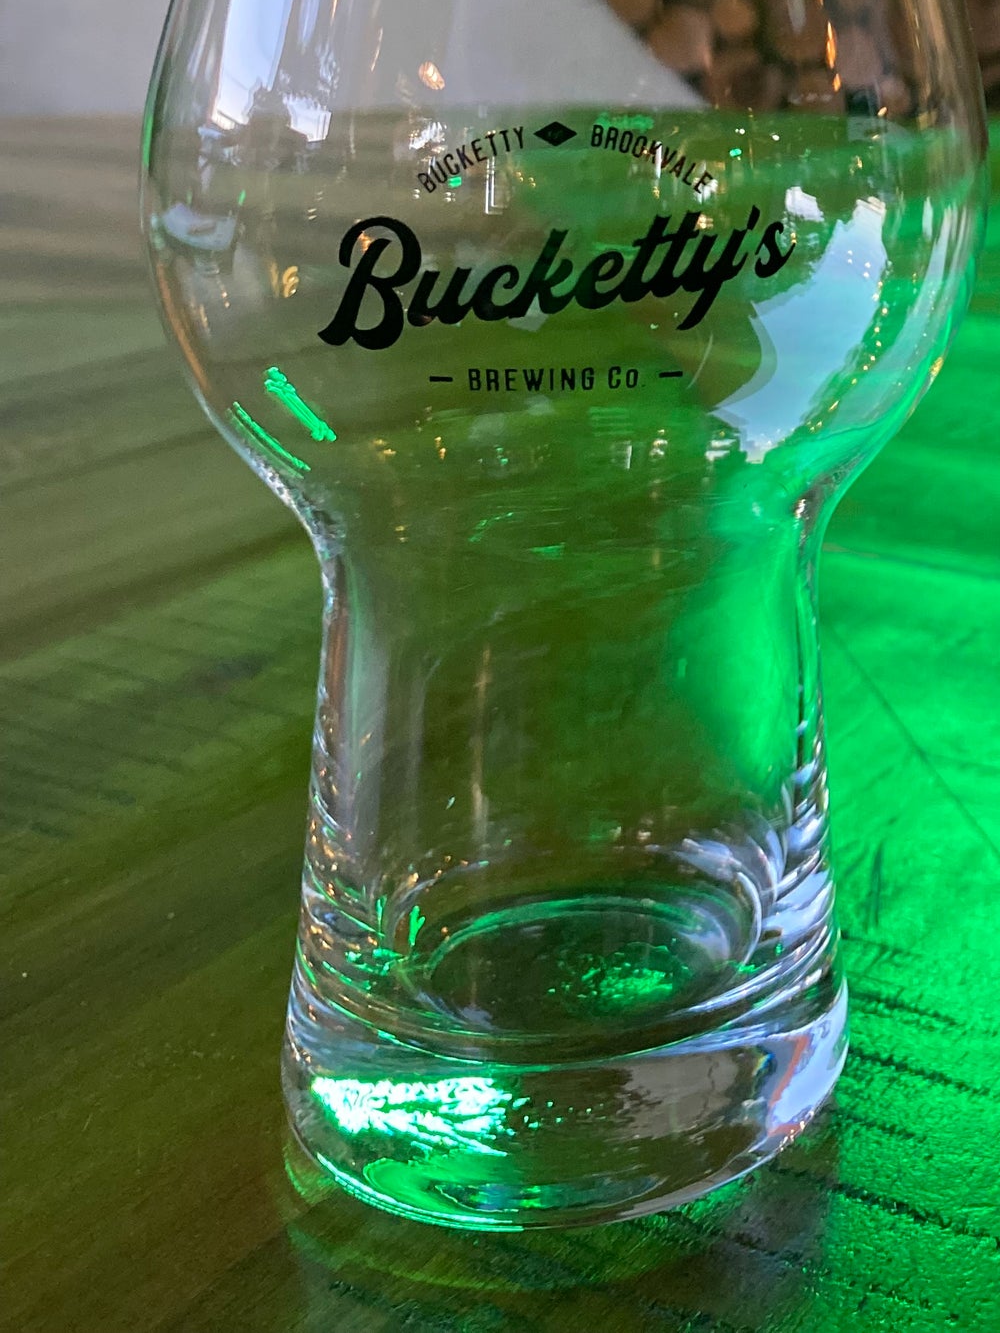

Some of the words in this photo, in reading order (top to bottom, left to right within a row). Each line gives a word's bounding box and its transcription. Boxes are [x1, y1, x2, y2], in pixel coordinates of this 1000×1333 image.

[416, 126, 525, 194] BUCKETTY
[590, 124, 716, 195] BROOKVALE
[317, 205, 797, 351] Bucketty's
[467, 366, 596, 392] BREWING
